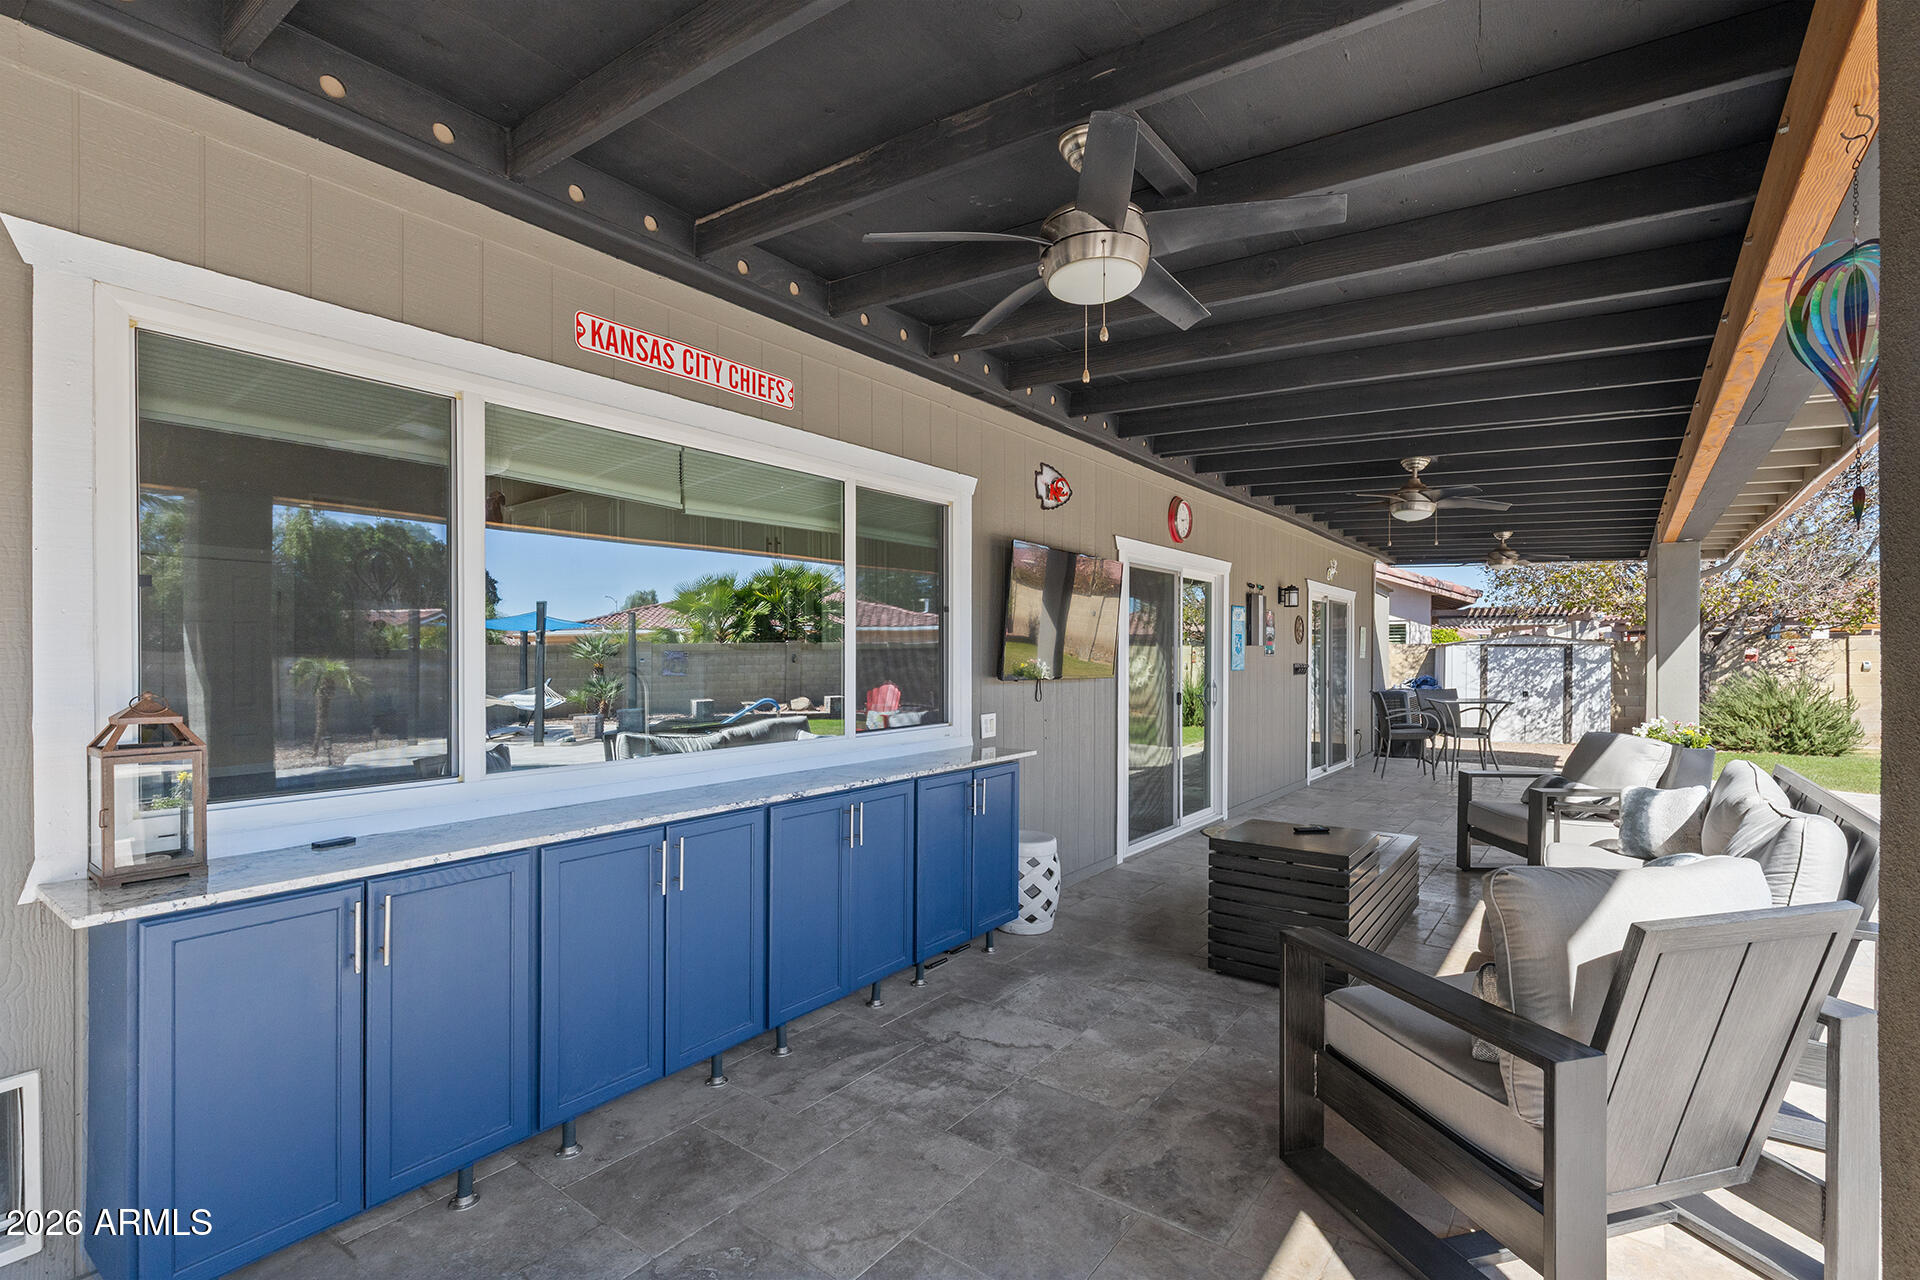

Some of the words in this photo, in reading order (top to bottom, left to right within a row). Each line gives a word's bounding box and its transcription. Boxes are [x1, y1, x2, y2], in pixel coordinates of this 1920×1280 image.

[591, 319, 675, 370] KANSAS
[682, 348, 723, 383] CITY
[728, 364, 785, 403] CHIEFS
